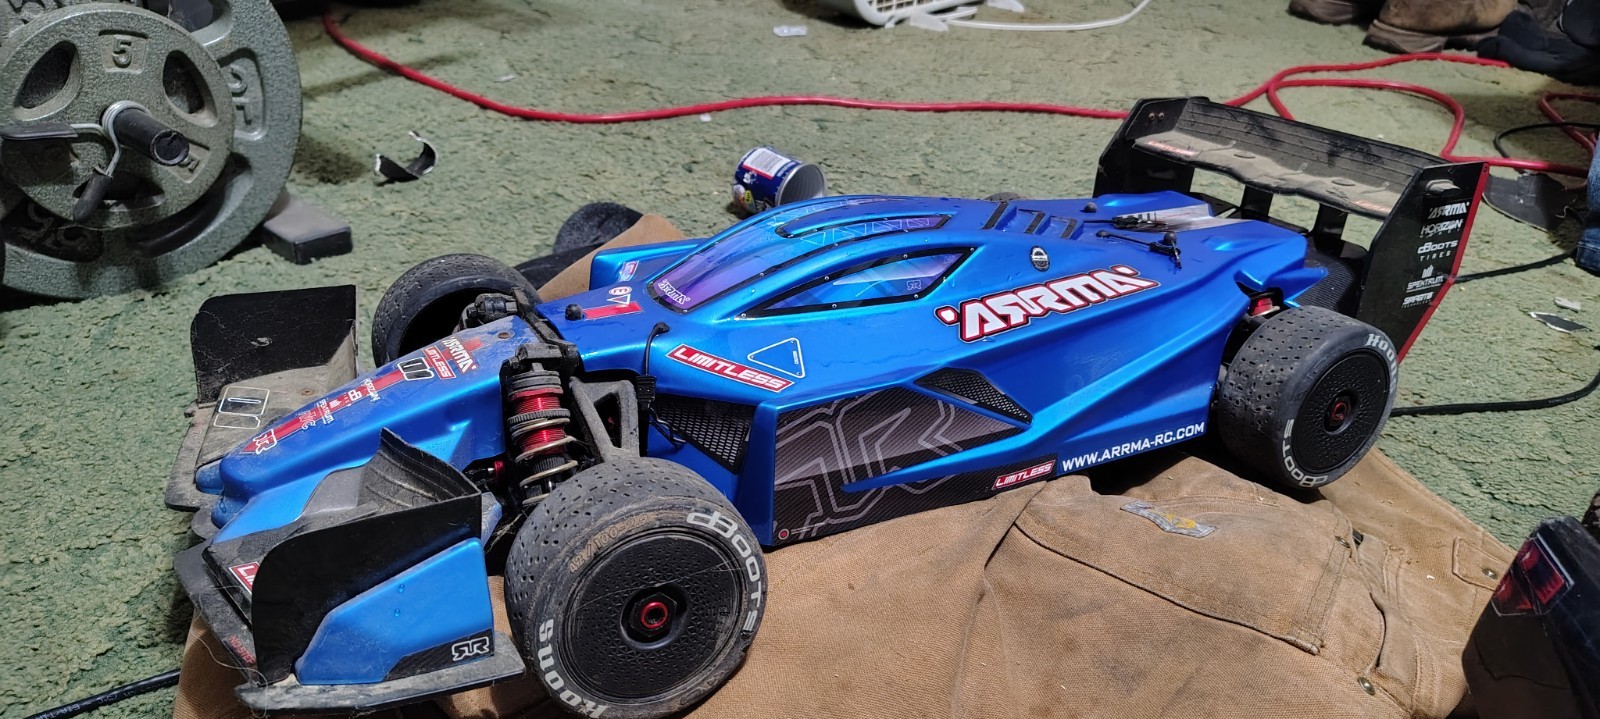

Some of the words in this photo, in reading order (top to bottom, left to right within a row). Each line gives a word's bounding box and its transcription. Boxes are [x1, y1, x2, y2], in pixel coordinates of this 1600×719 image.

[112, 37, 132, 69] 5
[1420, 250, 1451, 261] TIRES
[937, 266, 1160, 342] ARRMA
[673, 347, 787, 389] LIMITLESS
[1062, 422, 1205, 472] WWW.ARRMA-RC.COM
[995, 463, 1053, 487] LIMITLESS
